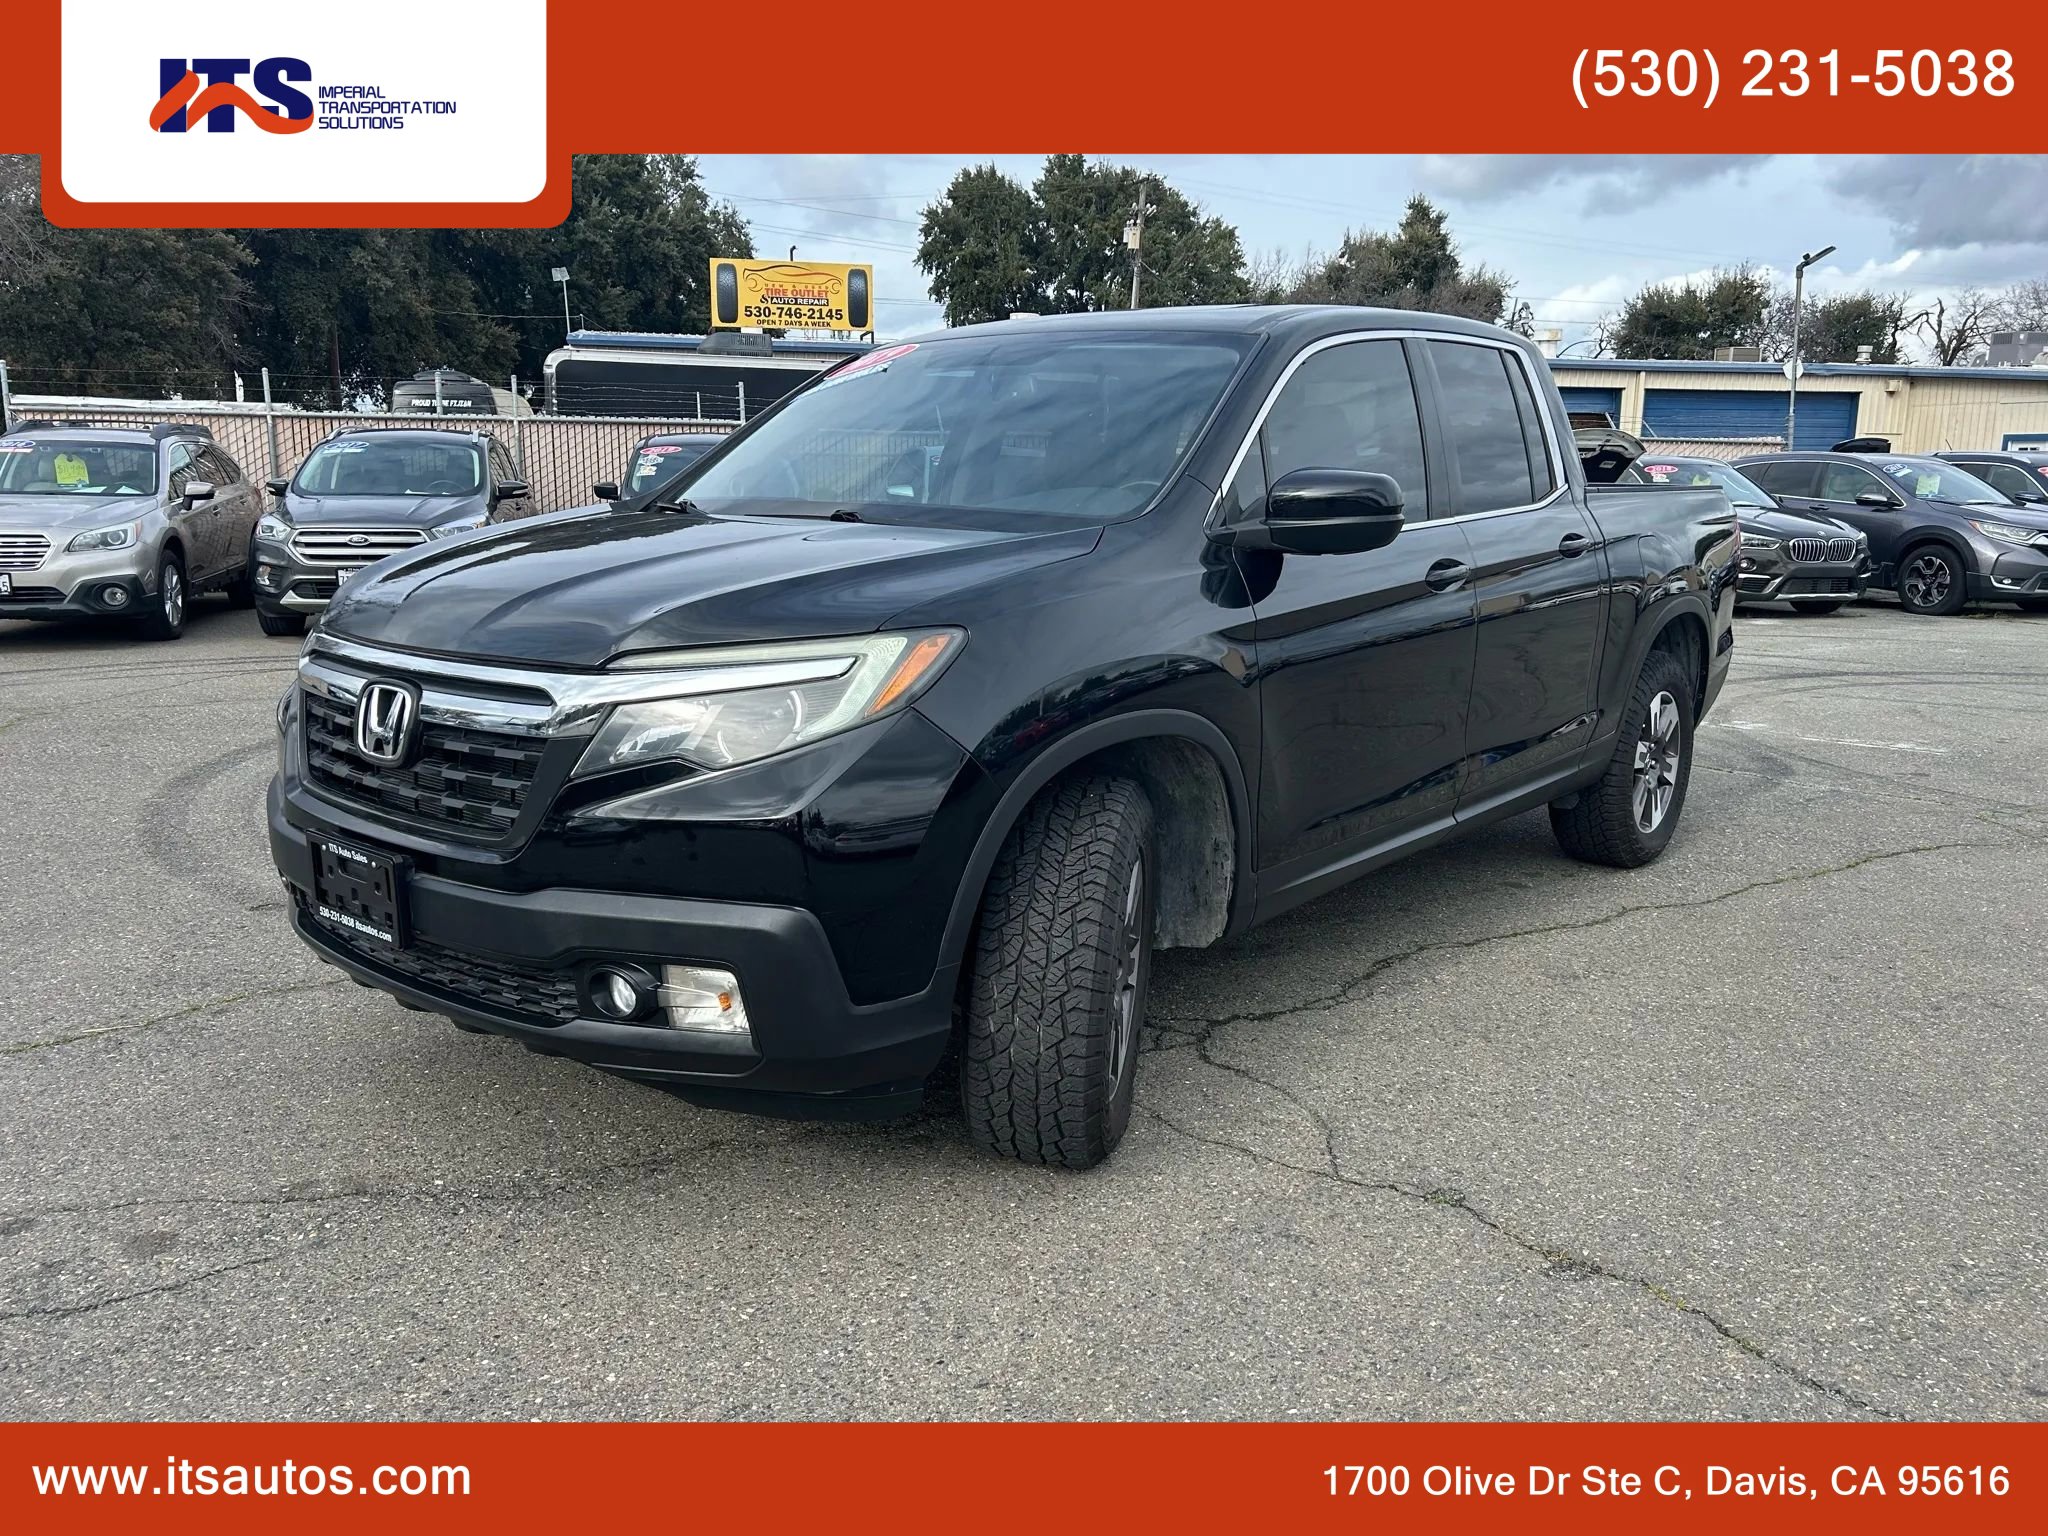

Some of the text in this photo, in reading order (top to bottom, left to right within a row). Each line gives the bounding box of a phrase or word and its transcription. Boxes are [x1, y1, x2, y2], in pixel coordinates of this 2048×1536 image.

[765, 288, 829, 298] TIRE OUTLET
[797, 298, 828, 306] REPAIR
[744, 306, 843, 320] 530-746-2145
[411, 399, 431, 407] PROUD
[328, 843, 368, 863] ITS Auto Sales
[319, 906, 392, 942] 530-231-5038 itsautos.com
